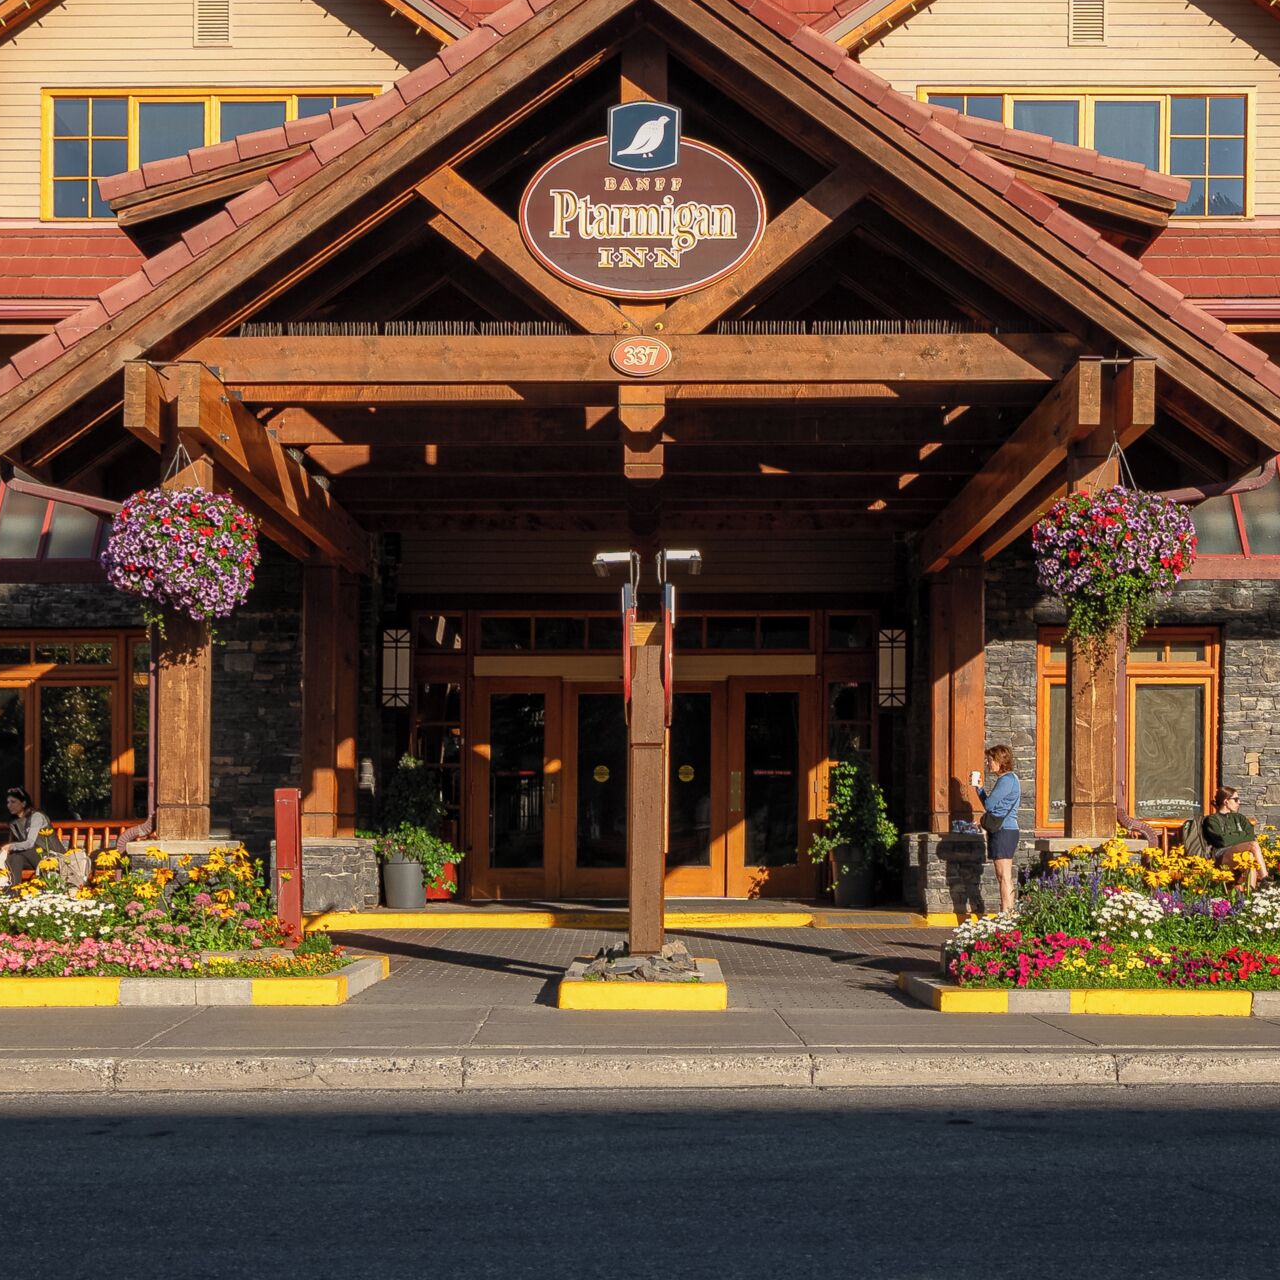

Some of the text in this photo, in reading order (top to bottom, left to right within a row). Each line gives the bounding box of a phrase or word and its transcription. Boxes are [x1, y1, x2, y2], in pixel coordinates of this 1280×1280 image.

[604, 177, 683, 191] BANFF
[549, 189, 737, 251] Ptarmigan
[623, 346, 661, 366] 337
[1157, 799, 1200, 808] MEATBALL
